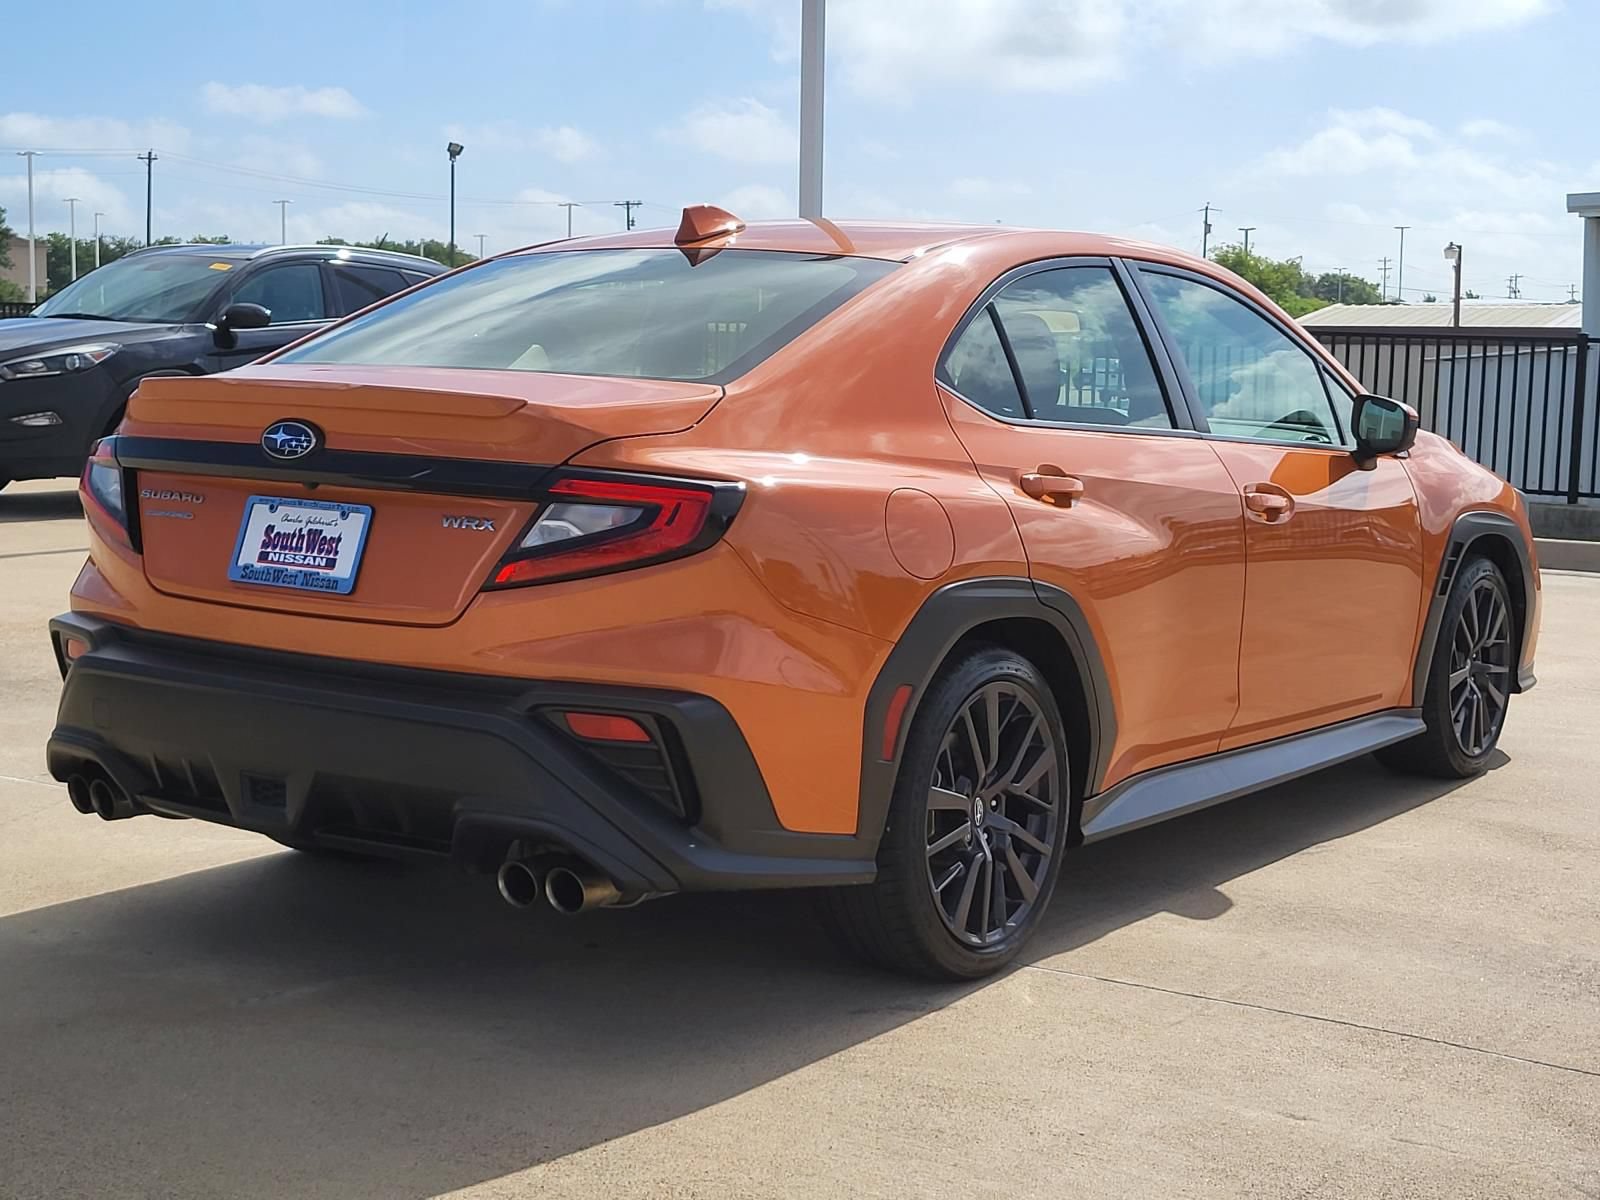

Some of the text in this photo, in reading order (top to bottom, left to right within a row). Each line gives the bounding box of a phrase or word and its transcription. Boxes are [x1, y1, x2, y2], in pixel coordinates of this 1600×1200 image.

[140, 489, 204, 503] SUBARU
[441, 517, 496, 532] WRX
[260, 524, 342, 556] SouthWest
[268, 552, 327, 567] NISSAN
[240, 565, 339, 591] SouthWest Nissan
